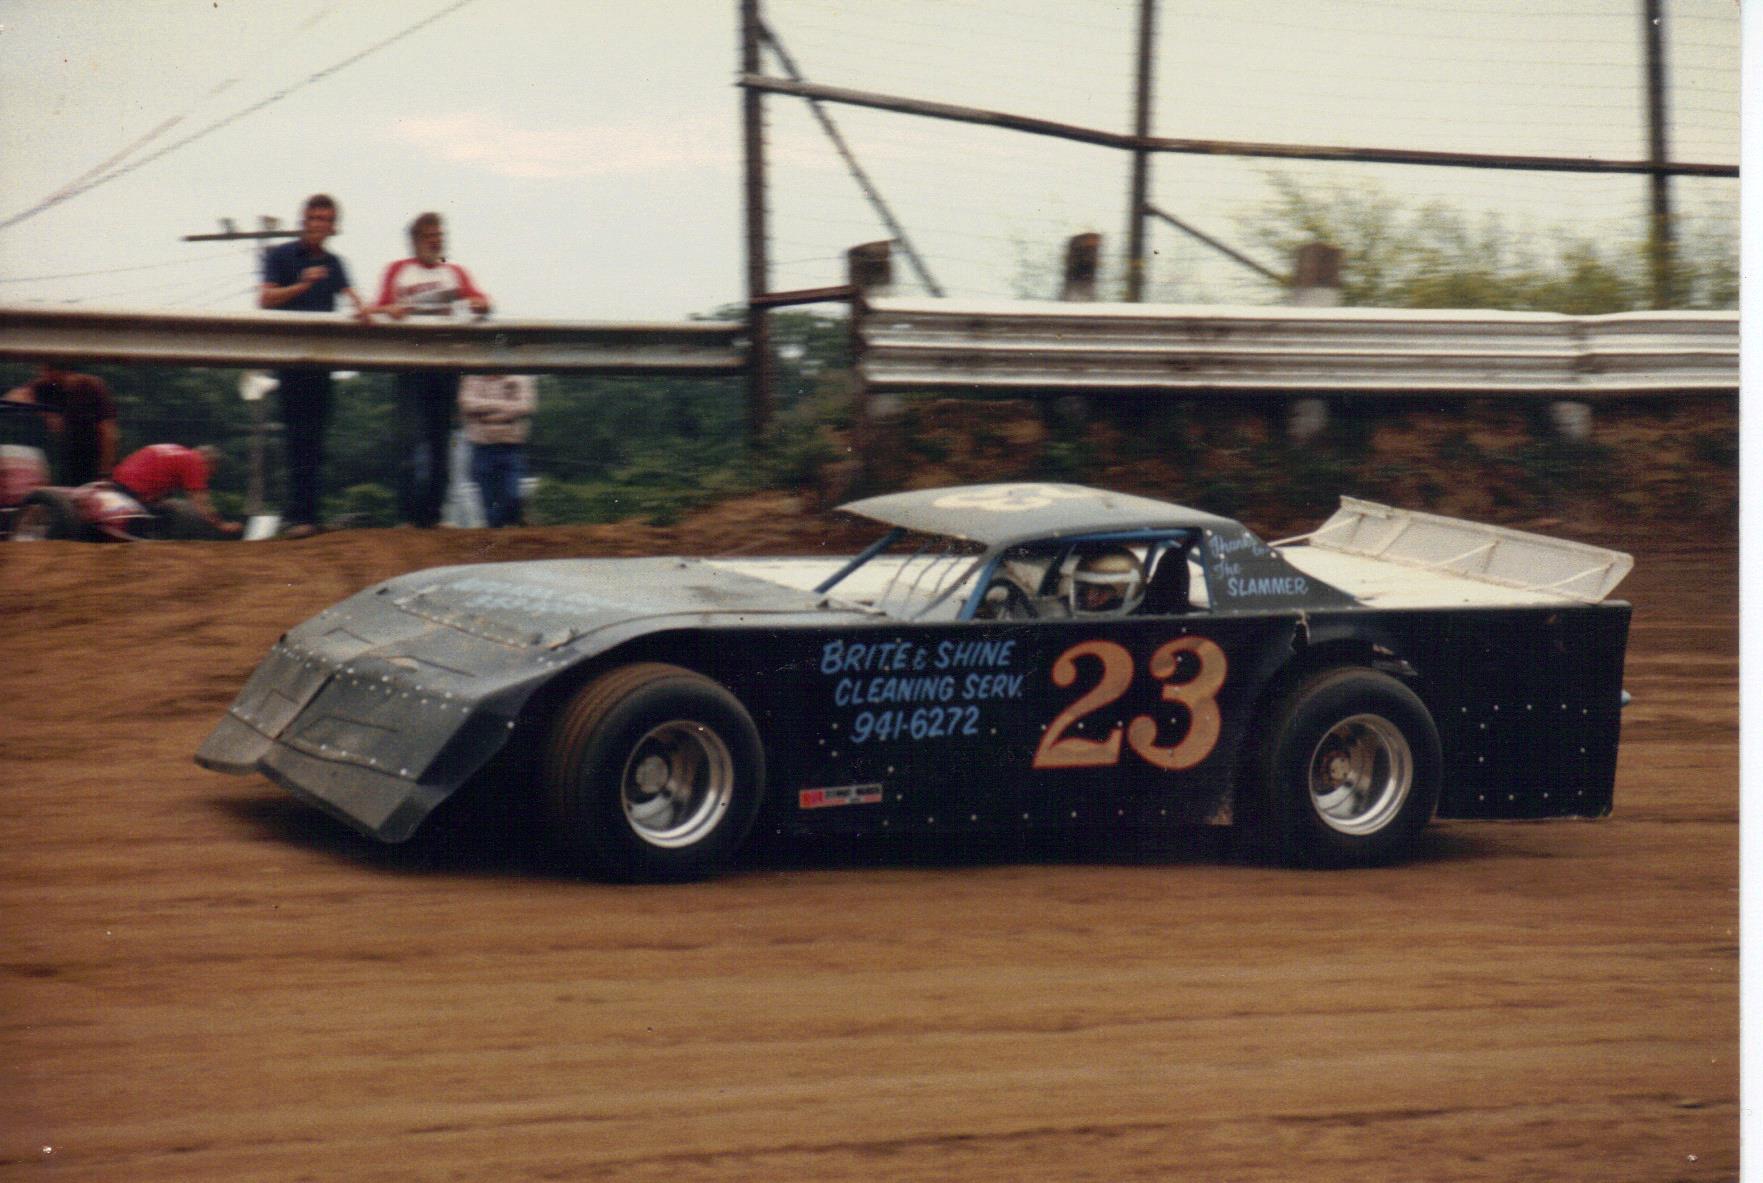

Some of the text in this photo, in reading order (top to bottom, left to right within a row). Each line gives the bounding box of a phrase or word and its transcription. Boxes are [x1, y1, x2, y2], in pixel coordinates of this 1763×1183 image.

[1227, 577, 1309, 597] SLAMMER
[820, 641, 912, 674] BRITE
[934, 640, 1016, 669] SHINE
[835, 672, 1025, 706] CLEANING SERV.
[1032, 636, 1227, 770] 23
[851, 704, 980, 743] 941-6272
